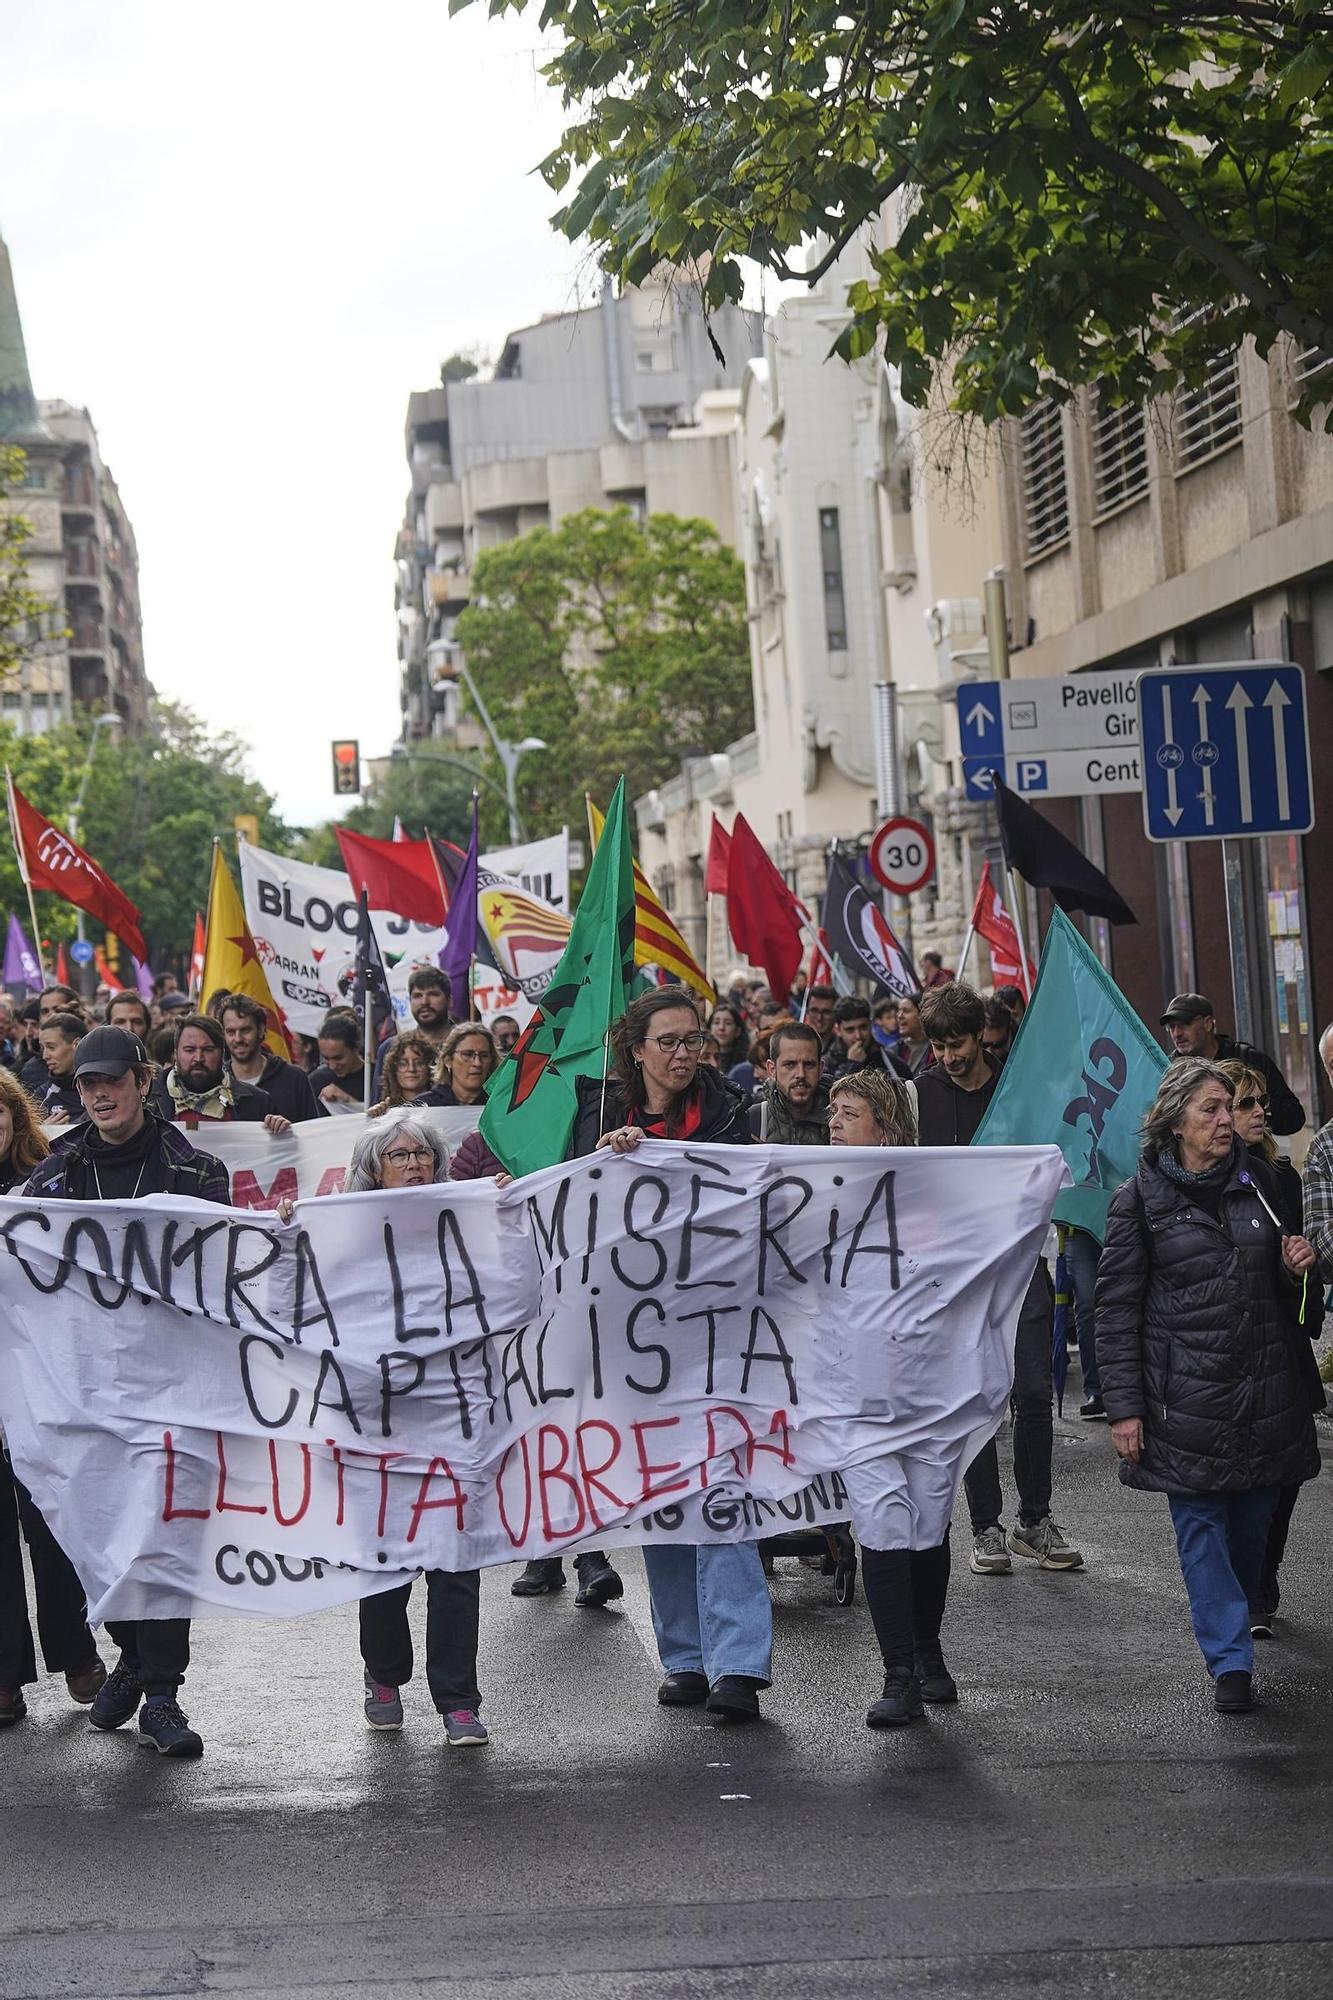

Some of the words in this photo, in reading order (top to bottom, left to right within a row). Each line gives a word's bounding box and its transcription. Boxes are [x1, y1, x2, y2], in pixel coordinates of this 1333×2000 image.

[1062, 682, 1136, 707] Pavelló
[1105, 713, 1138, 736] Gir
[1087, 759, 1139, 782] Cent
[887, 844, 922, 869] 30
[274, 955, 320, 980] ARRAN
[0, 1211, 340, 1347] CONTRA
[383, 1208, 491, 1347] LA
[496, 1405, 797, 1548] OBRERA
